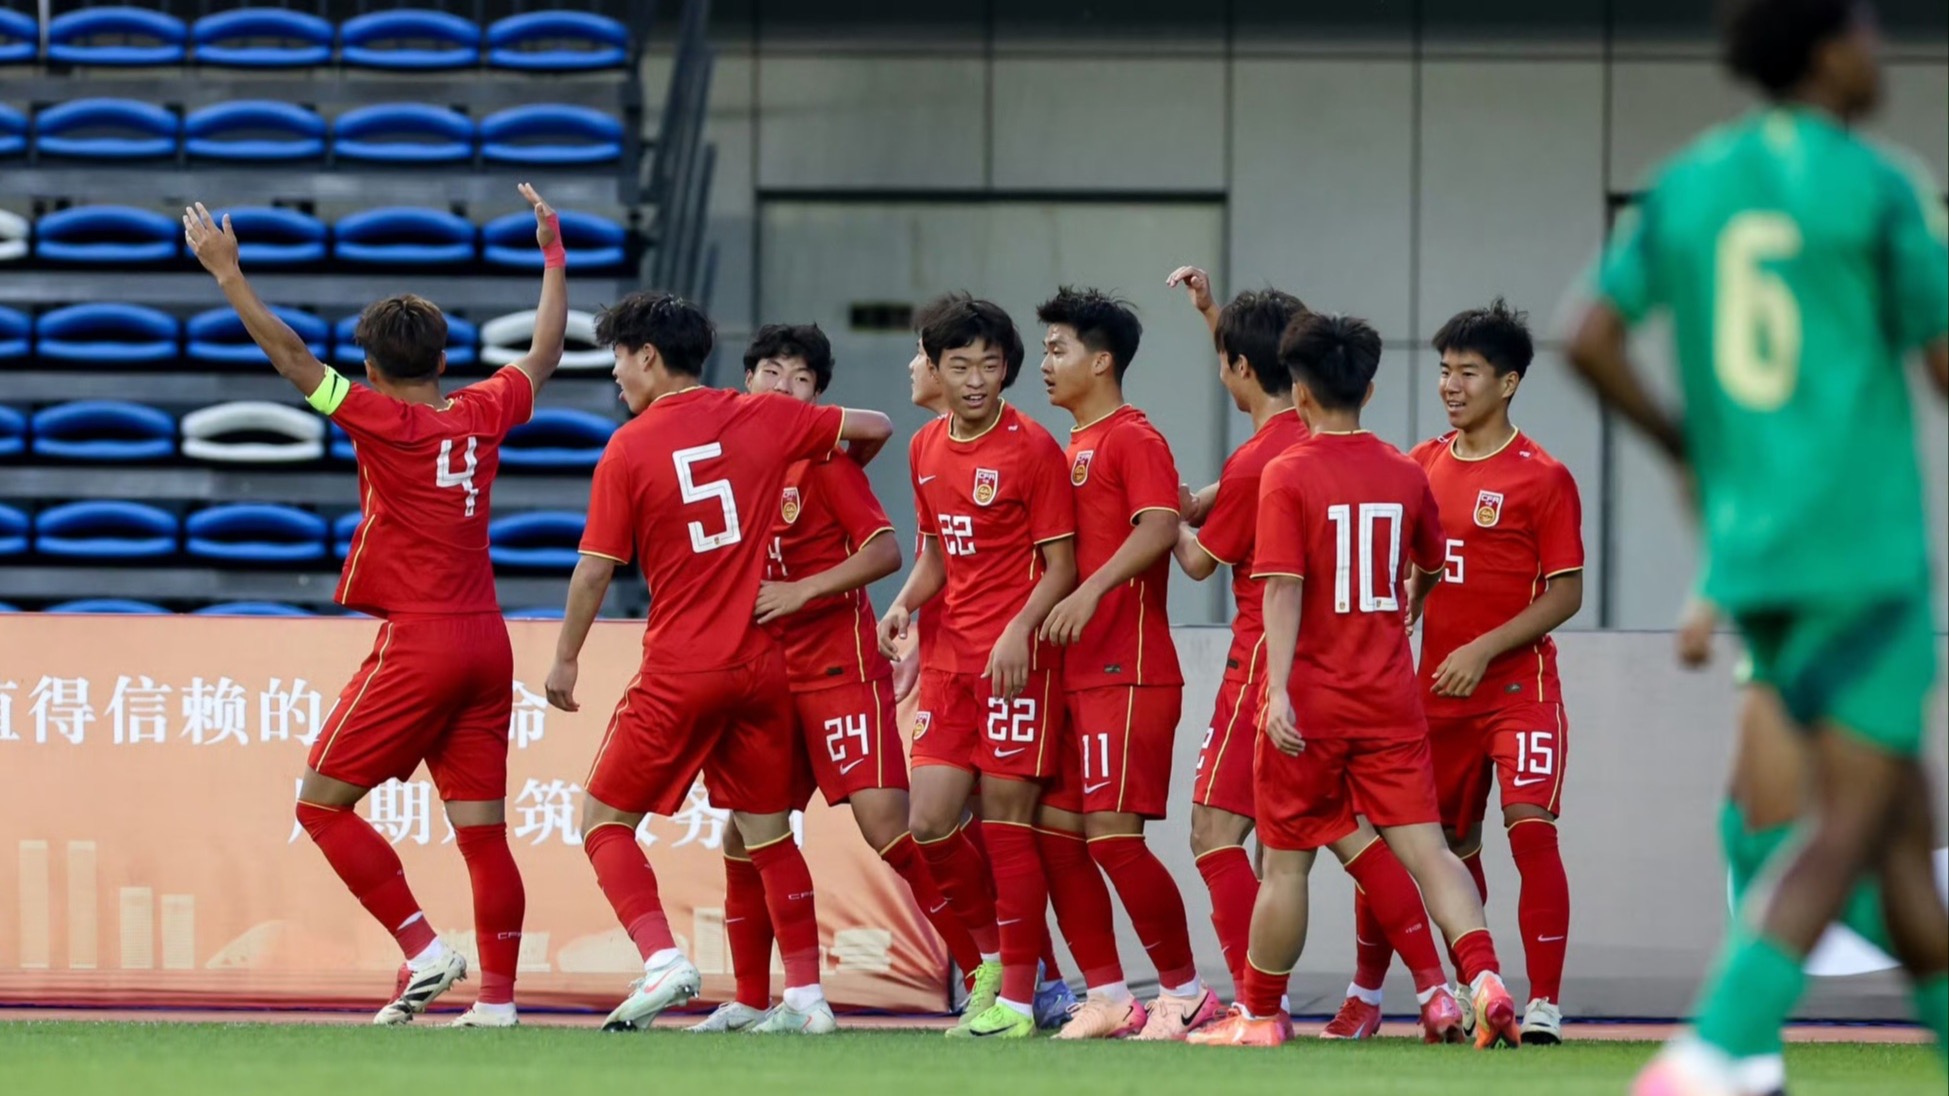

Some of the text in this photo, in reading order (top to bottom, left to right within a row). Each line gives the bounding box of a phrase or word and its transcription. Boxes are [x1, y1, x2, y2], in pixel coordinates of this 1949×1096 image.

[1713, 208, 1803, 413] 6
[436, 436, 479, 517] 4
[672, 441, 742, 553] 5
[938, 513, 976, 556] 22
[1328, 503, 1403, 614] 10
[1439, 538, 1465, 584] 5
[824, 713, 869, 762] 24
[987, 697, 1035, 742] 22
[1082, 733, 1109, 778] 11
[1516, 731, 1553, 774] 15
